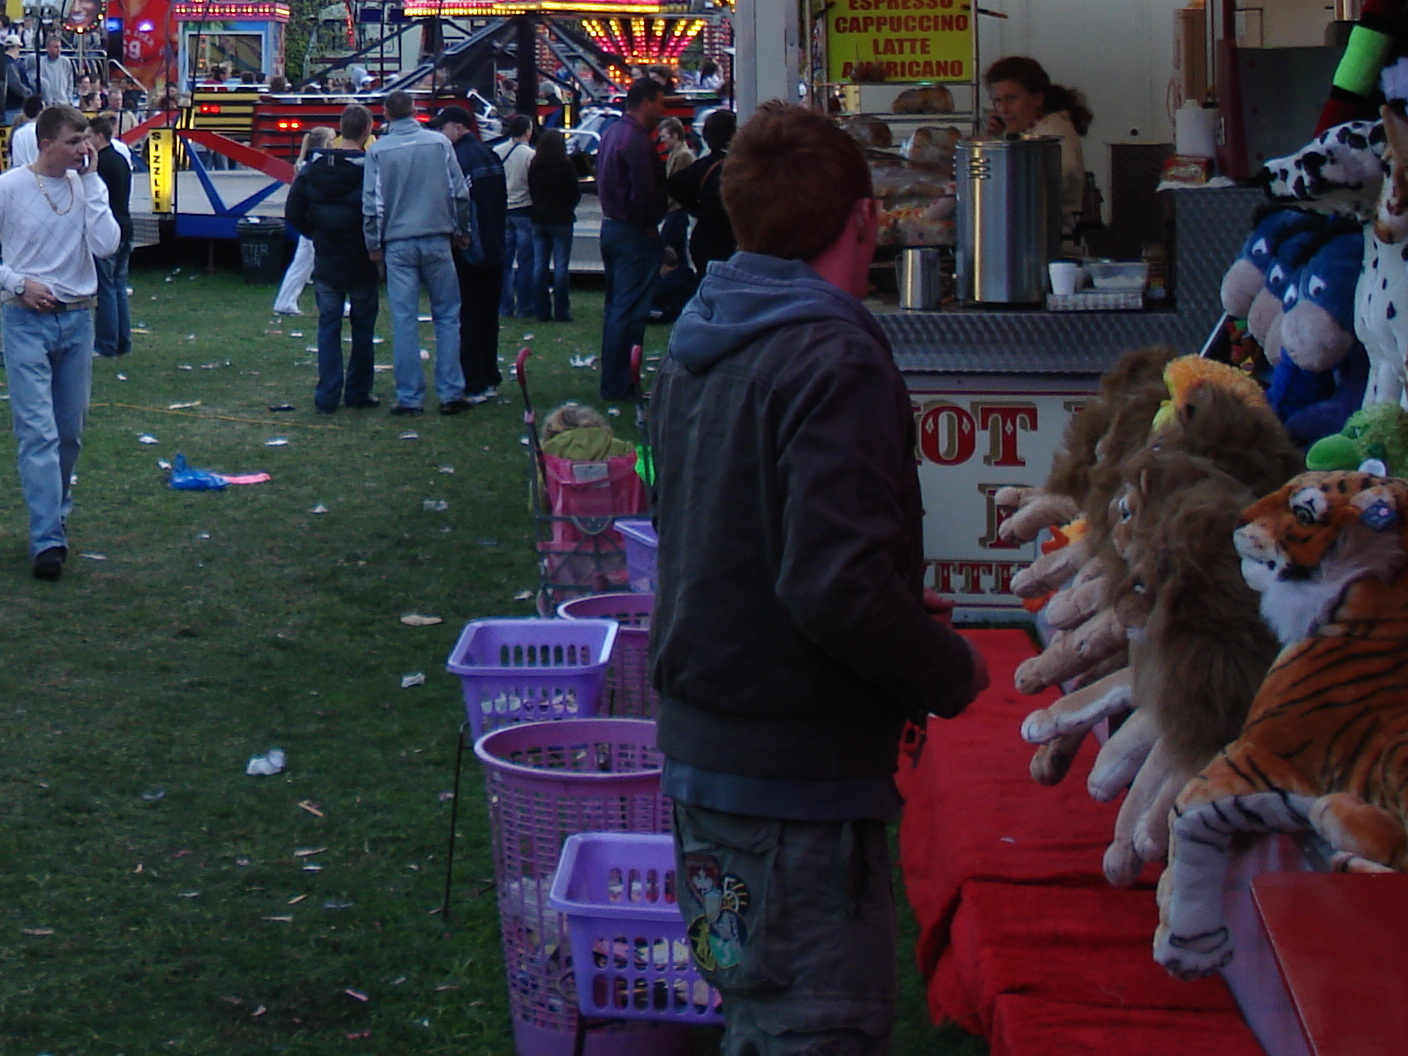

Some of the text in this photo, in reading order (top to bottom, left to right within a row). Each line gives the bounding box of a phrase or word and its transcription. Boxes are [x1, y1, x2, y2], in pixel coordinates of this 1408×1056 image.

[835, 14, 968, 33] CAPPUCCINO
[872, 38, 930, 55] LATTE
[914, 400, 1038, 467] OT
